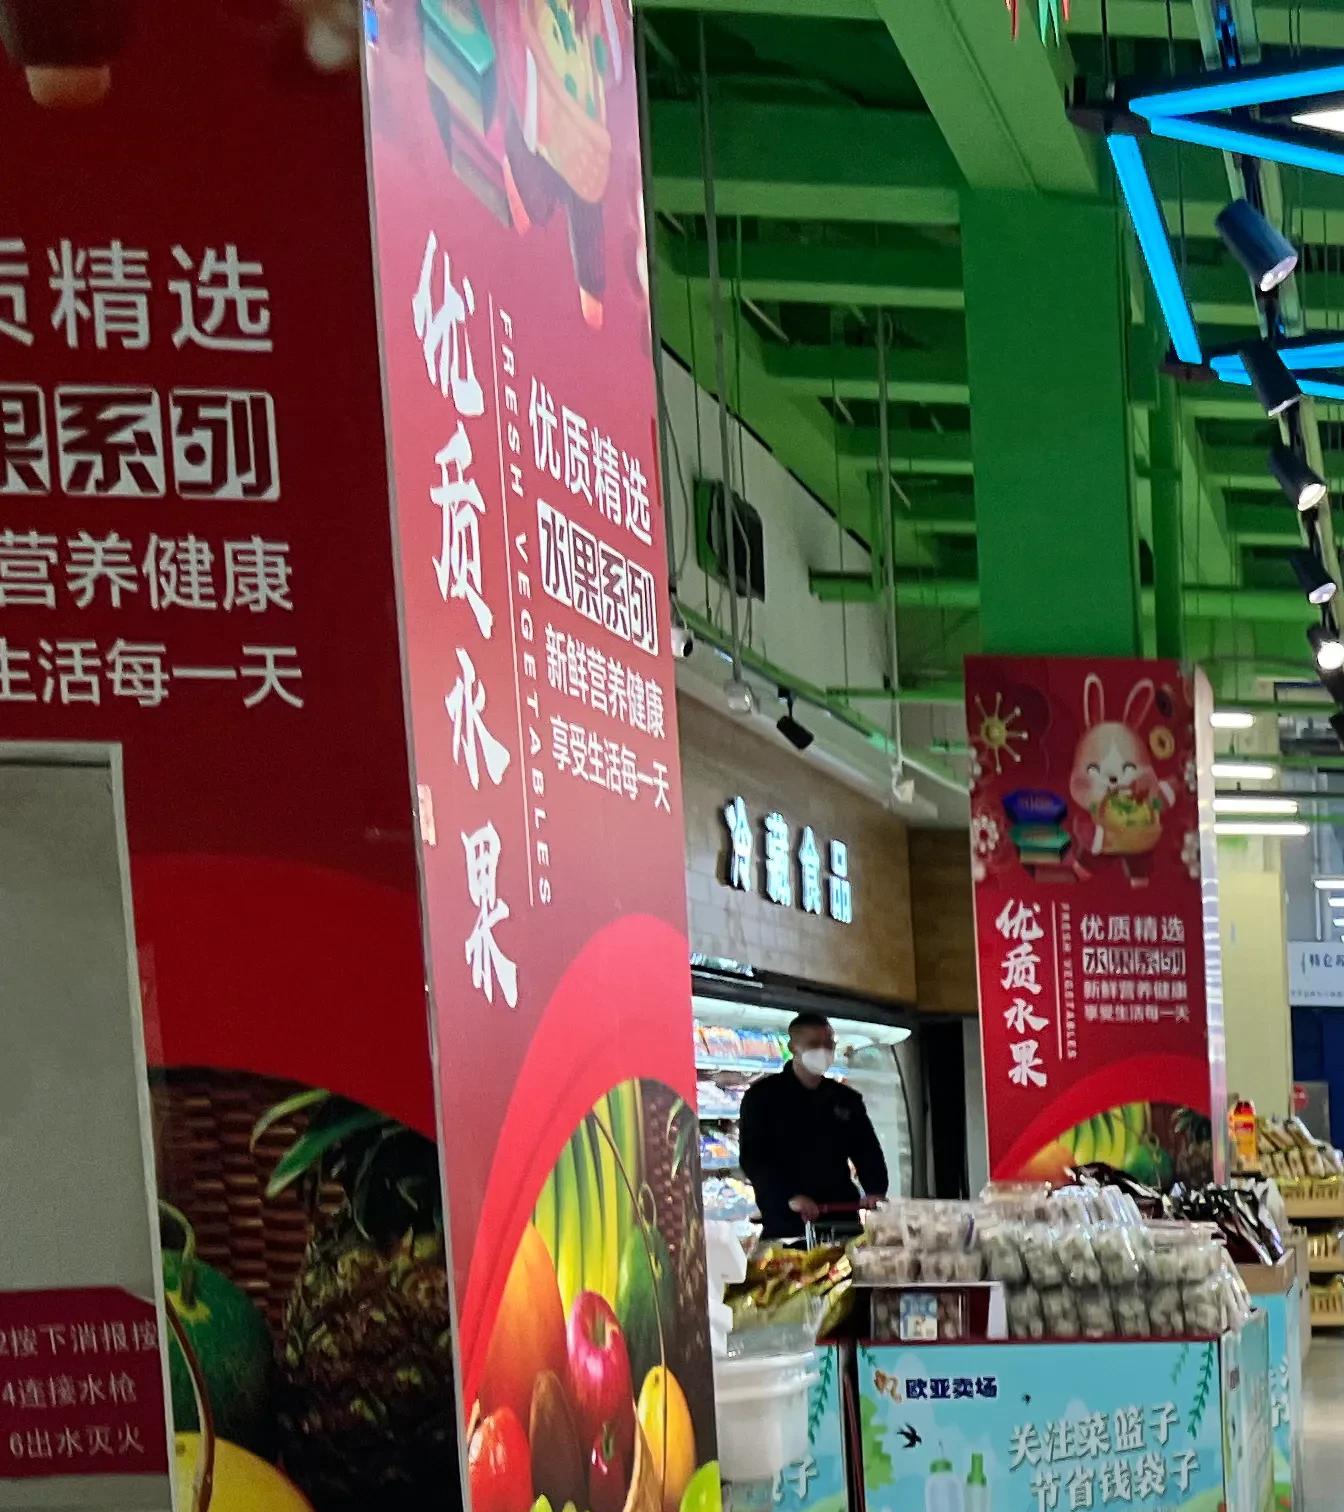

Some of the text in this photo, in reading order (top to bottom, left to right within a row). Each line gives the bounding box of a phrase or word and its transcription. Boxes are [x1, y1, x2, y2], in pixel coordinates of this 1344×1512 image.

[528, 375, 652, 546] 优质精选
[0, 529, 293, 612] 营养健康
[411, 230, 518, 1008] 优质水果
[500, 308, 551, 905] FRESH VEGETABLES
[537, 498, 659, 657] 水果系列
[544, 622, 665, 740] 新鲜营养健康
[549, 714, 671, 814] 享受生活每一天
[1080, 914, 1186, 943] 优质精选
[995, 899, 1050, 1087] 优质水果
[905, 1376, 998, 1399] 欧亚卖场
[1009, 1401, 1180, 1472] 关注菜篮子
